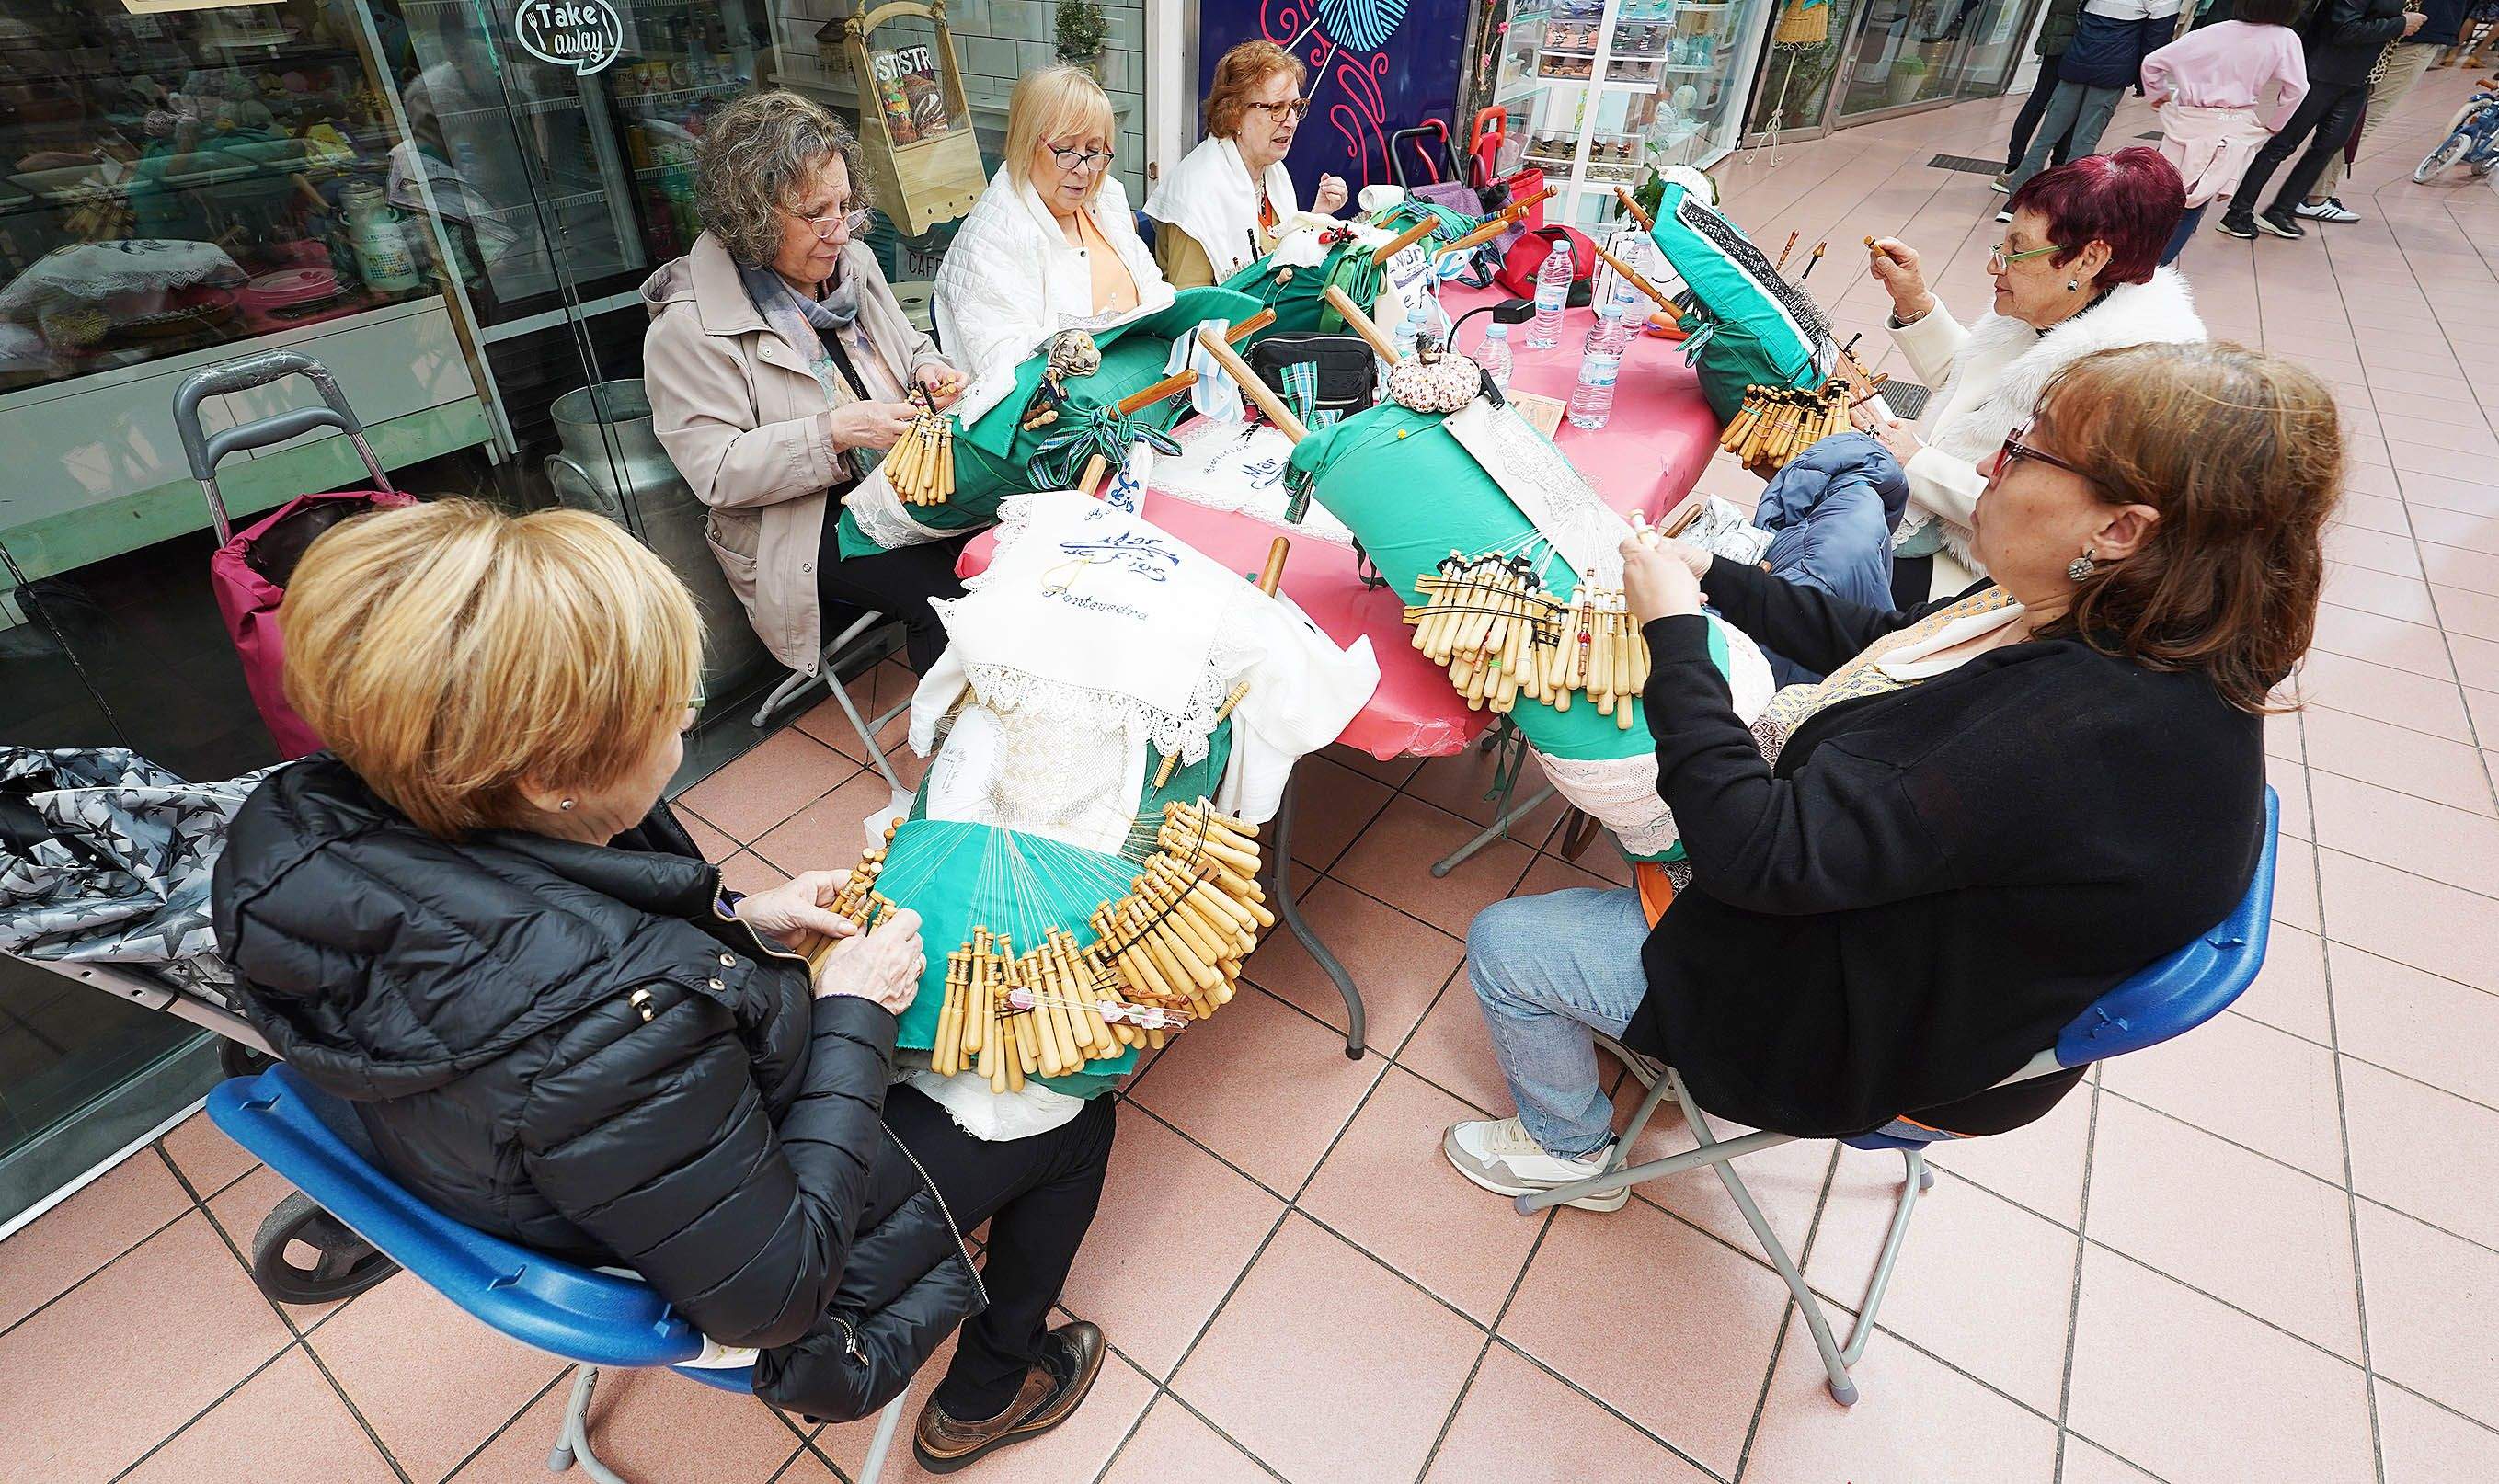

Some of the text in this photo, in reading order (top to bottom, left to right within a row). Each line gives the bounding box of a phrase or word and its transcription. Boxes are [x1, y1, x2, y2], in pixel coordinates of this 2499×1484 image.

[535, 1, 598, 29] Take
[554, 29, 605, 63] away
[1041, 584, 1149, 622] Pontevedra
